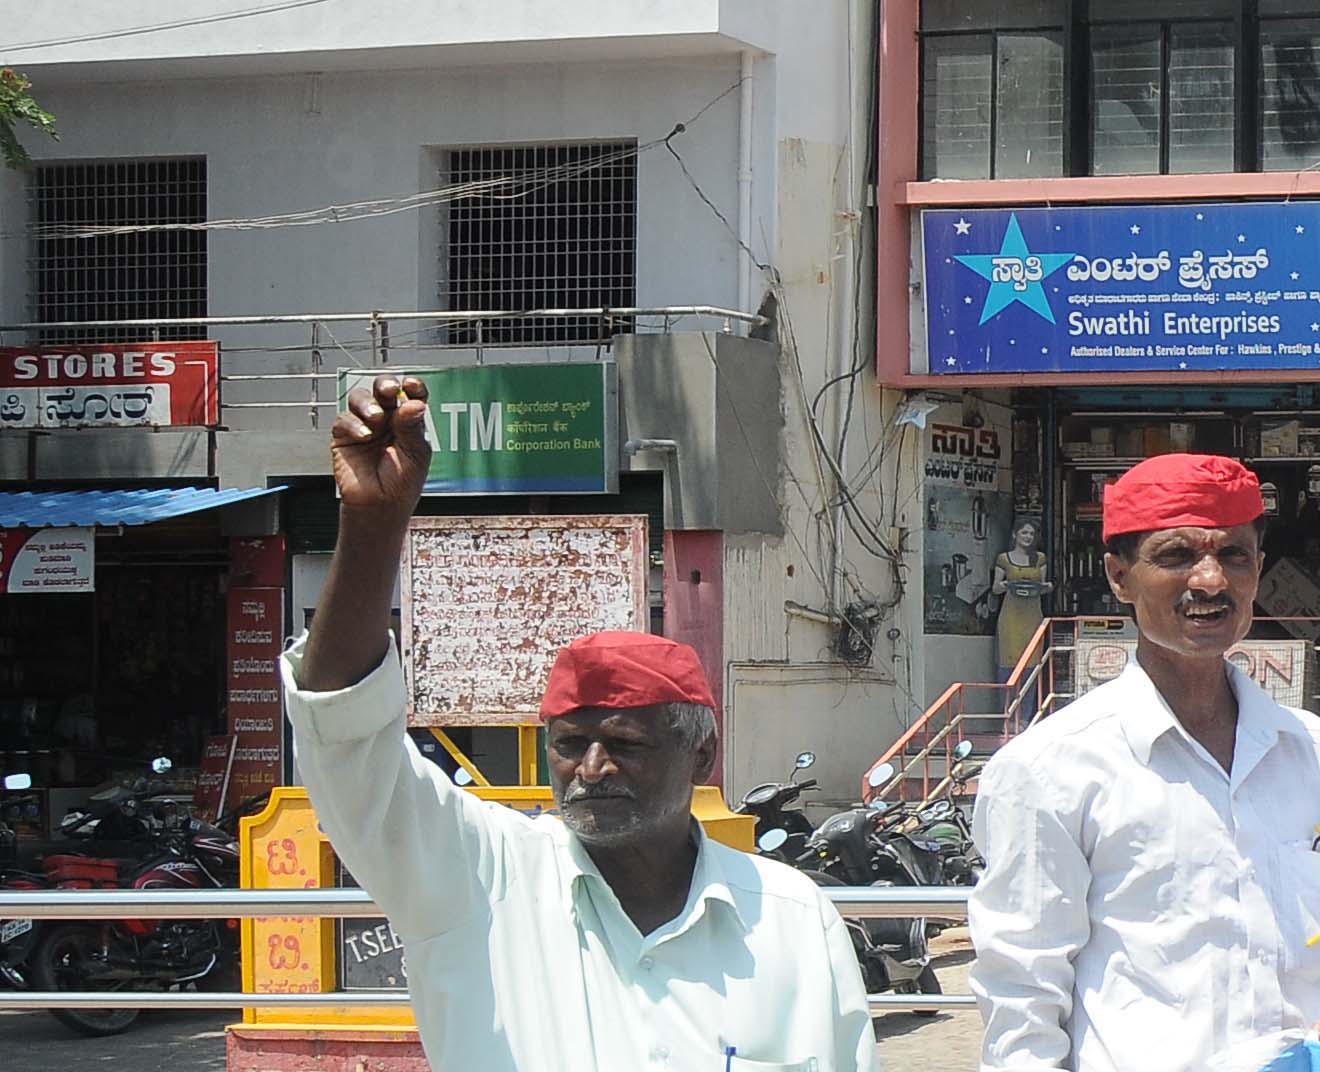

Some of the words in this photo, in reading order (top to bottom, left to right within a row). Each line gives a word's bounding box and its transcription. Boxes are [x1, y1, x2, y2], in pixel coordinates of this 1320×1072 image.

[992, 256, 1043, 290] ಸ್ವಾತಿ
[1067, 252, 1170, 281] ಎಂಟರ್
[1178, 248, 1269, 290] ಪ್ರೈಸಸ್
[1068, 309, 1150, 335] Swathi
[1164, 310, 1280, 340] Enterprises
[1071, 345, 1112, 357] Authorised
[1115, 345, 1144, 357] Dealers
[1147, 345, 1153, 356] &
[1155, 345, 1185, 356] Service
[1187, 344, 1213, 356] Center
[1279, 343, 1312, 356] Prestige
[1314, 343, 1320, 354] &
[15, 352, 176, 379] STORES
[507, 439, 570, 452] Corporation
[574, 438, 600, 449] Bank
